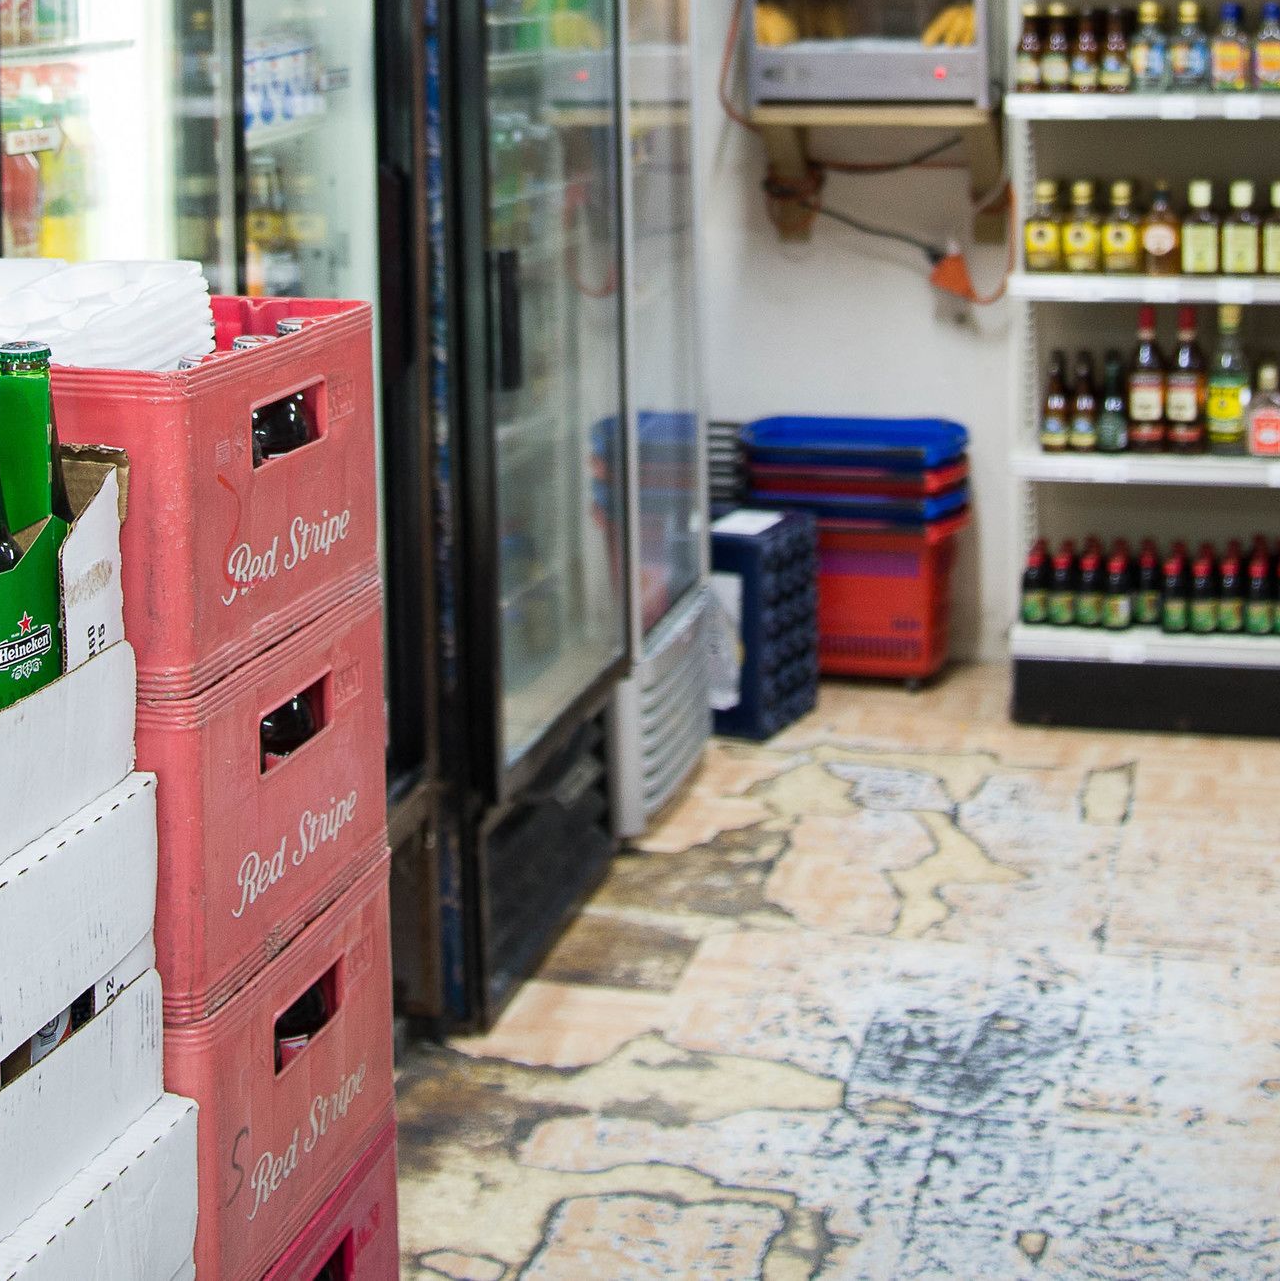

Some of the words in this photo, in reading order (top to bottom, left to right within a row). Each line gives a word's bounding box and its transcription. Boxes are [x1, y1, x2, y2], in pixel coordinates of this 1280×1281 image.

[221, 542, 279, 606] Red
[283, 507, 351, 569] Stripe
[230, 846, 288, 918] Red
[292, 789, 357, 855] Stripe
